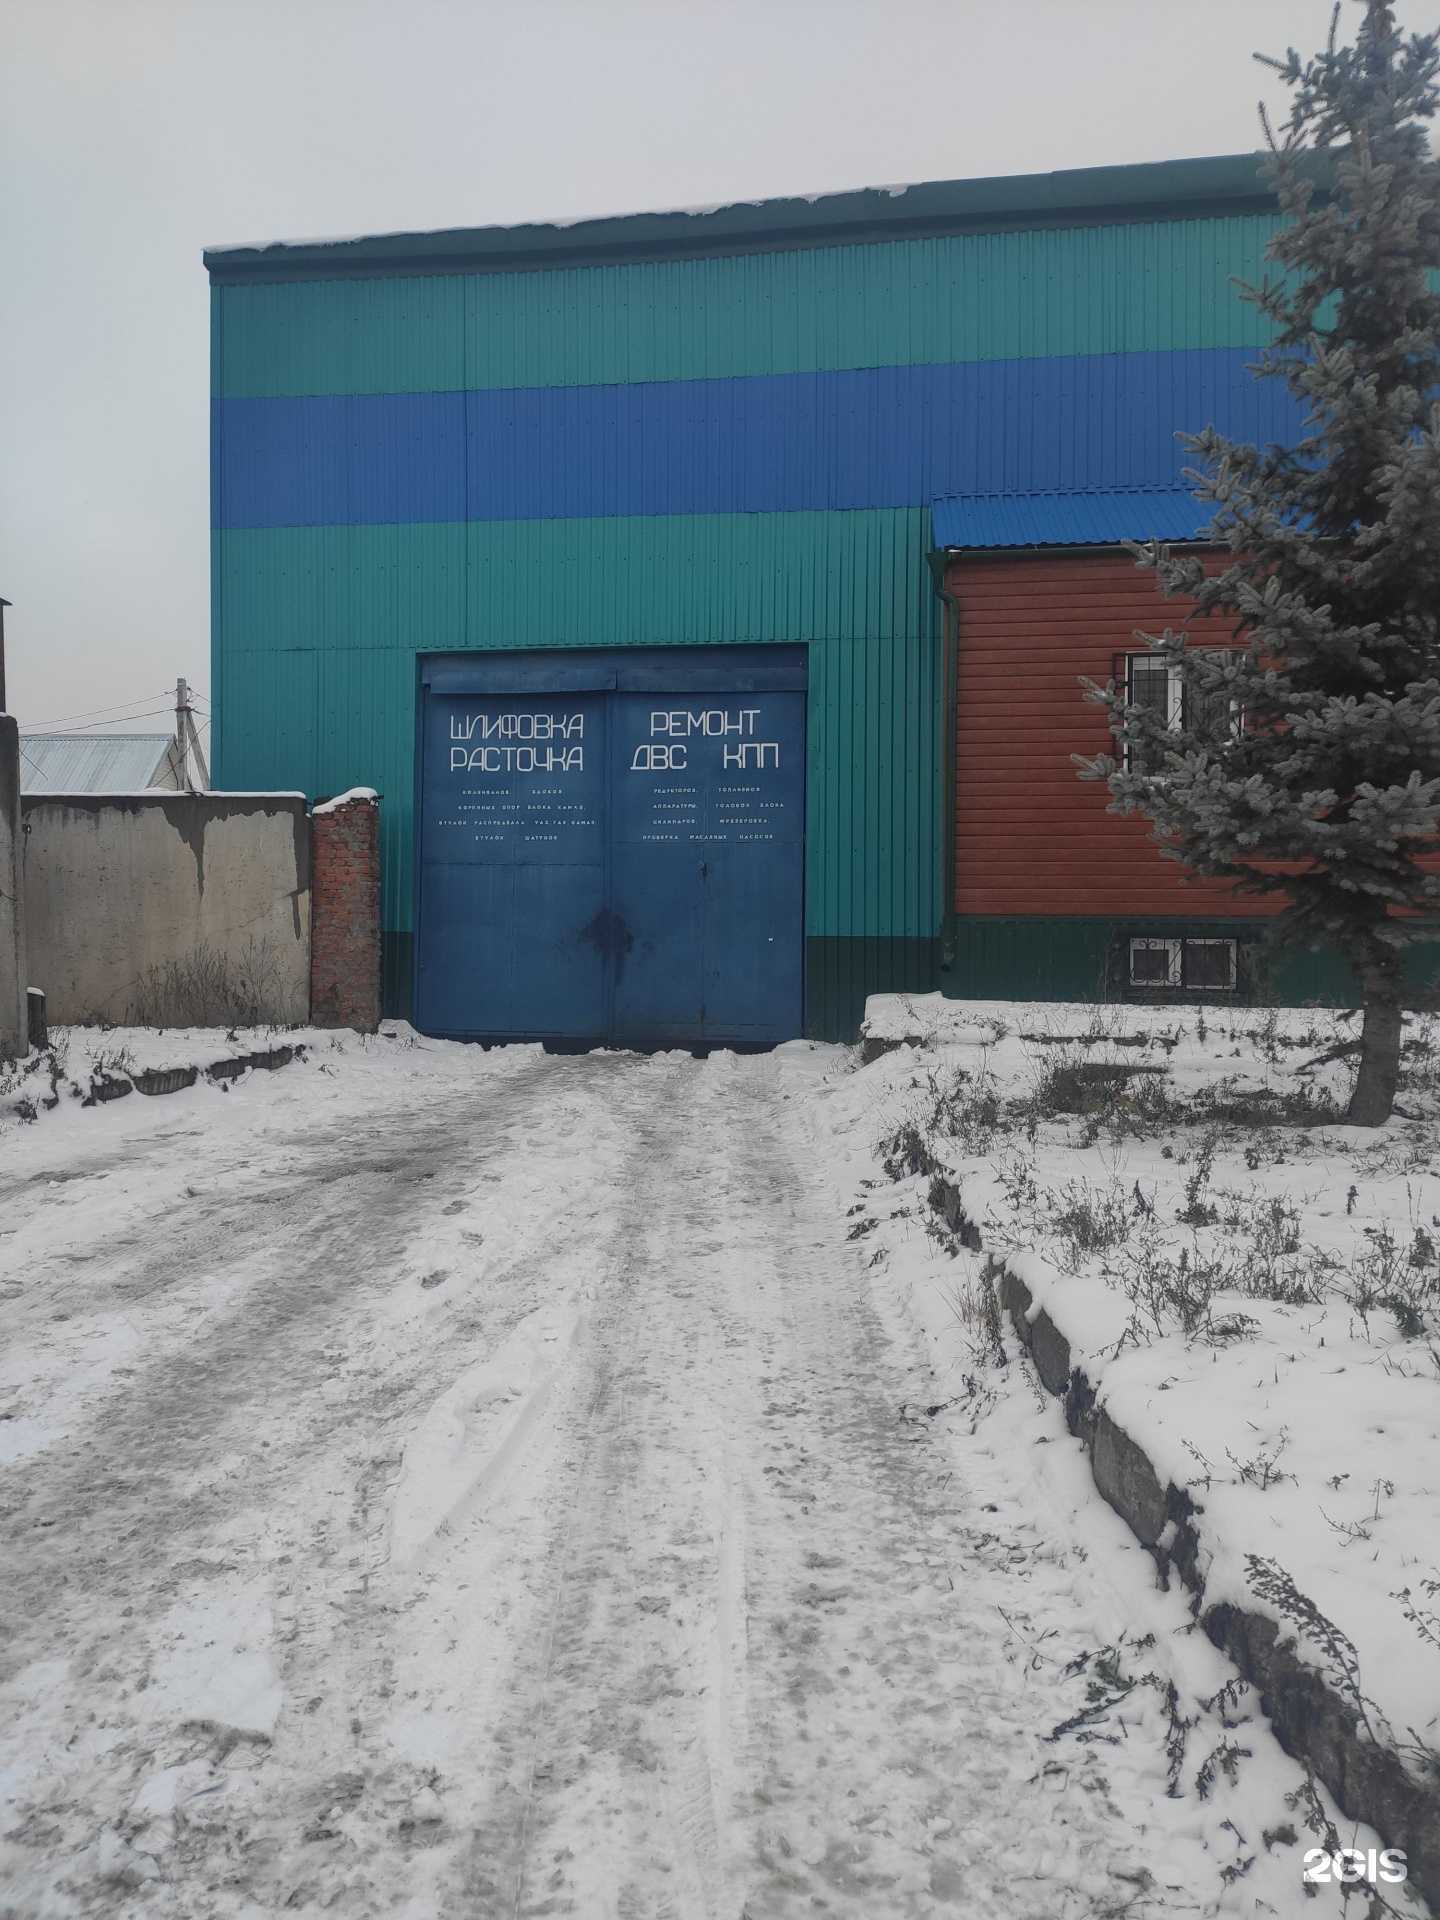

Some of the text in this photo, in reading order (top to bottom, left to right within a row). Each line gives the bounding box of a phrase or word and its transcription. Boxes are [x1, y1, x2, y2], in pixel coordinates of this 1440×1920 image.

[450, 713, 584, 740] ШЛИФОВКА
[650, 709, 761, 737] РЕМОНТ
[450, 746, 584, 772] РАСТОЧКА
[629, 742, 779, 770] ДВС КПП
